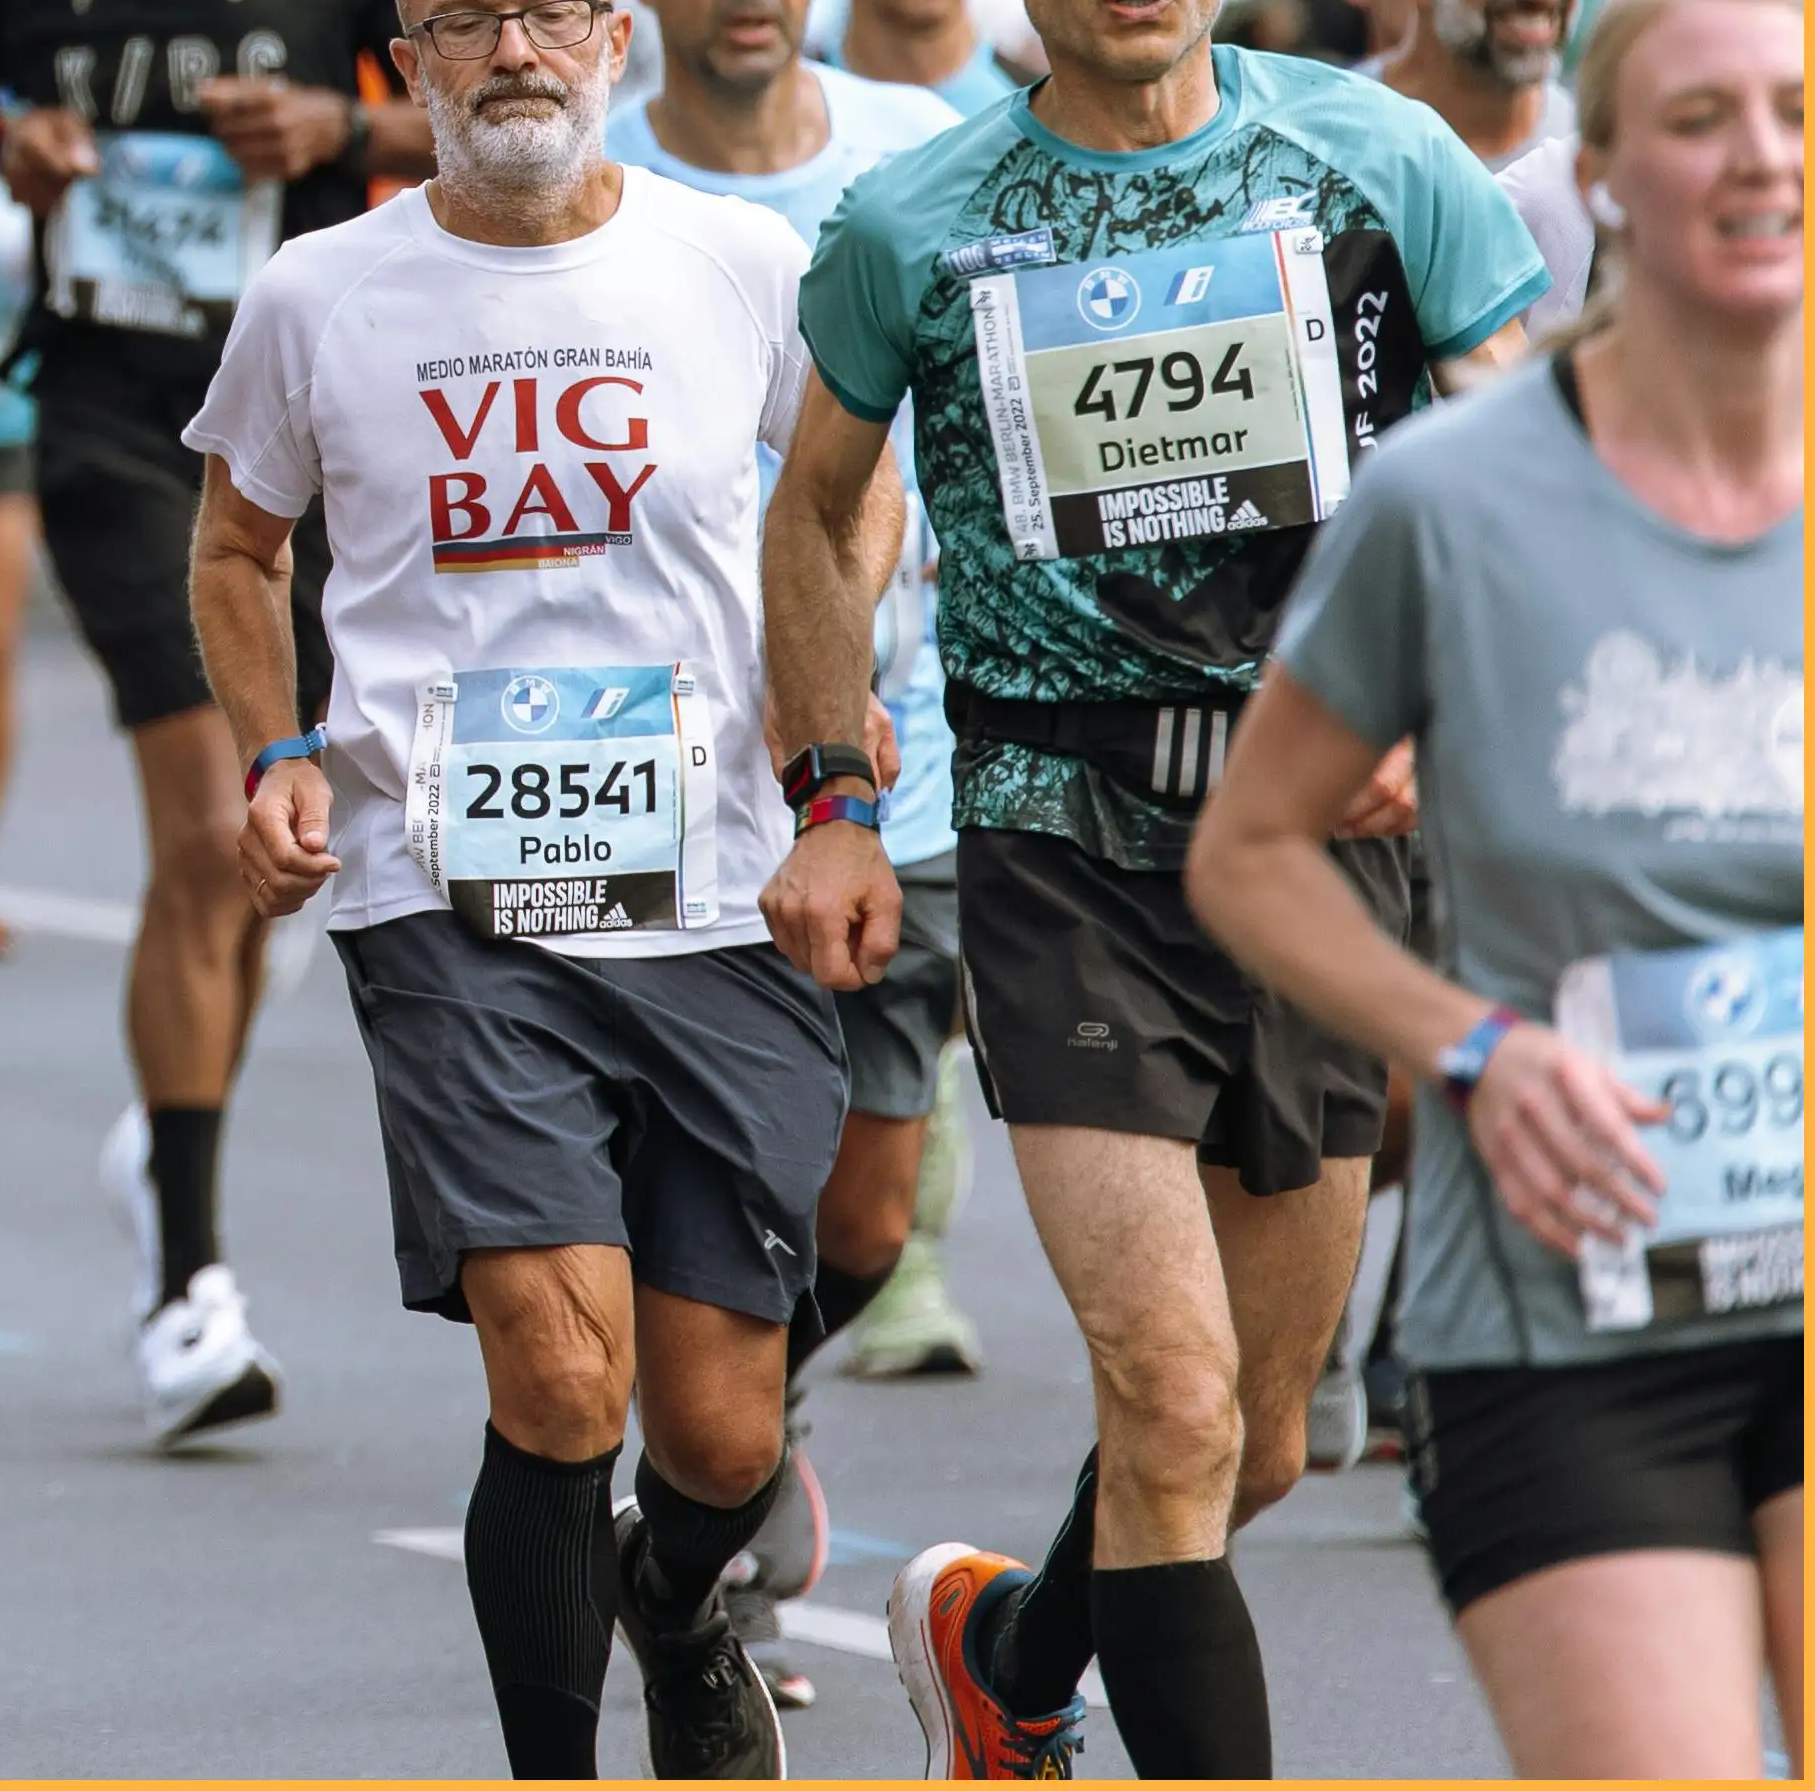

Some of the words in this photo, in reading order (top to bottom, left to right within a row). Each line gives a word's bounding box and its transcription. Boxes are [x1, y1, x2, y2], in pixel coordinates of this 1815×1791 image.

[1306, 318, 1325, 342] D
[1354, 290, 1389, 400] 2022
[416, 357, 465, 382] MEDIO
[468, 346, 549, 376] MARATÓN
[554, 347, 601, 368] GRAN
[605, 347, 654, 371] BAHÍA
[1074, 342, 1255, 423] 4794
[983, 309, 1020, 463] BERLIN-MARATHON
[418, 376, 649, 461] VIG
[1009, 397, 1028, 432] 2022
[1097, 428, 1249, 473] Dietmar
[1007, 467, 1025, 506] BMW
[1020, 434, 1043, 507] September
[428, 462, 659, 543] BAY
[1097, 476, 1231, 522] IMPOSSIBLE
[605, 535, 631, 545] VIGO
[1101, 520, 1127, 549] IS
[1127, 505, 1226, 546] NOTHING
[1226, 515, 1269, 532] adidas
[563, 543, 605, 556] NIGRÁN
[691, 745, 707, 767] D
[427, 784, 440, 816] 2022
[466, 759, 657, 819] 28541
[426, 818, 443, 888] September
[519, 833, 613, 864] Pablo
[493, 879, 608, 909] IMPOSSIBLE
[493, 908, 514, 935] IS
[516, 904, 599, 934] NOTHING
[599, 917, 633, 929] adidas
